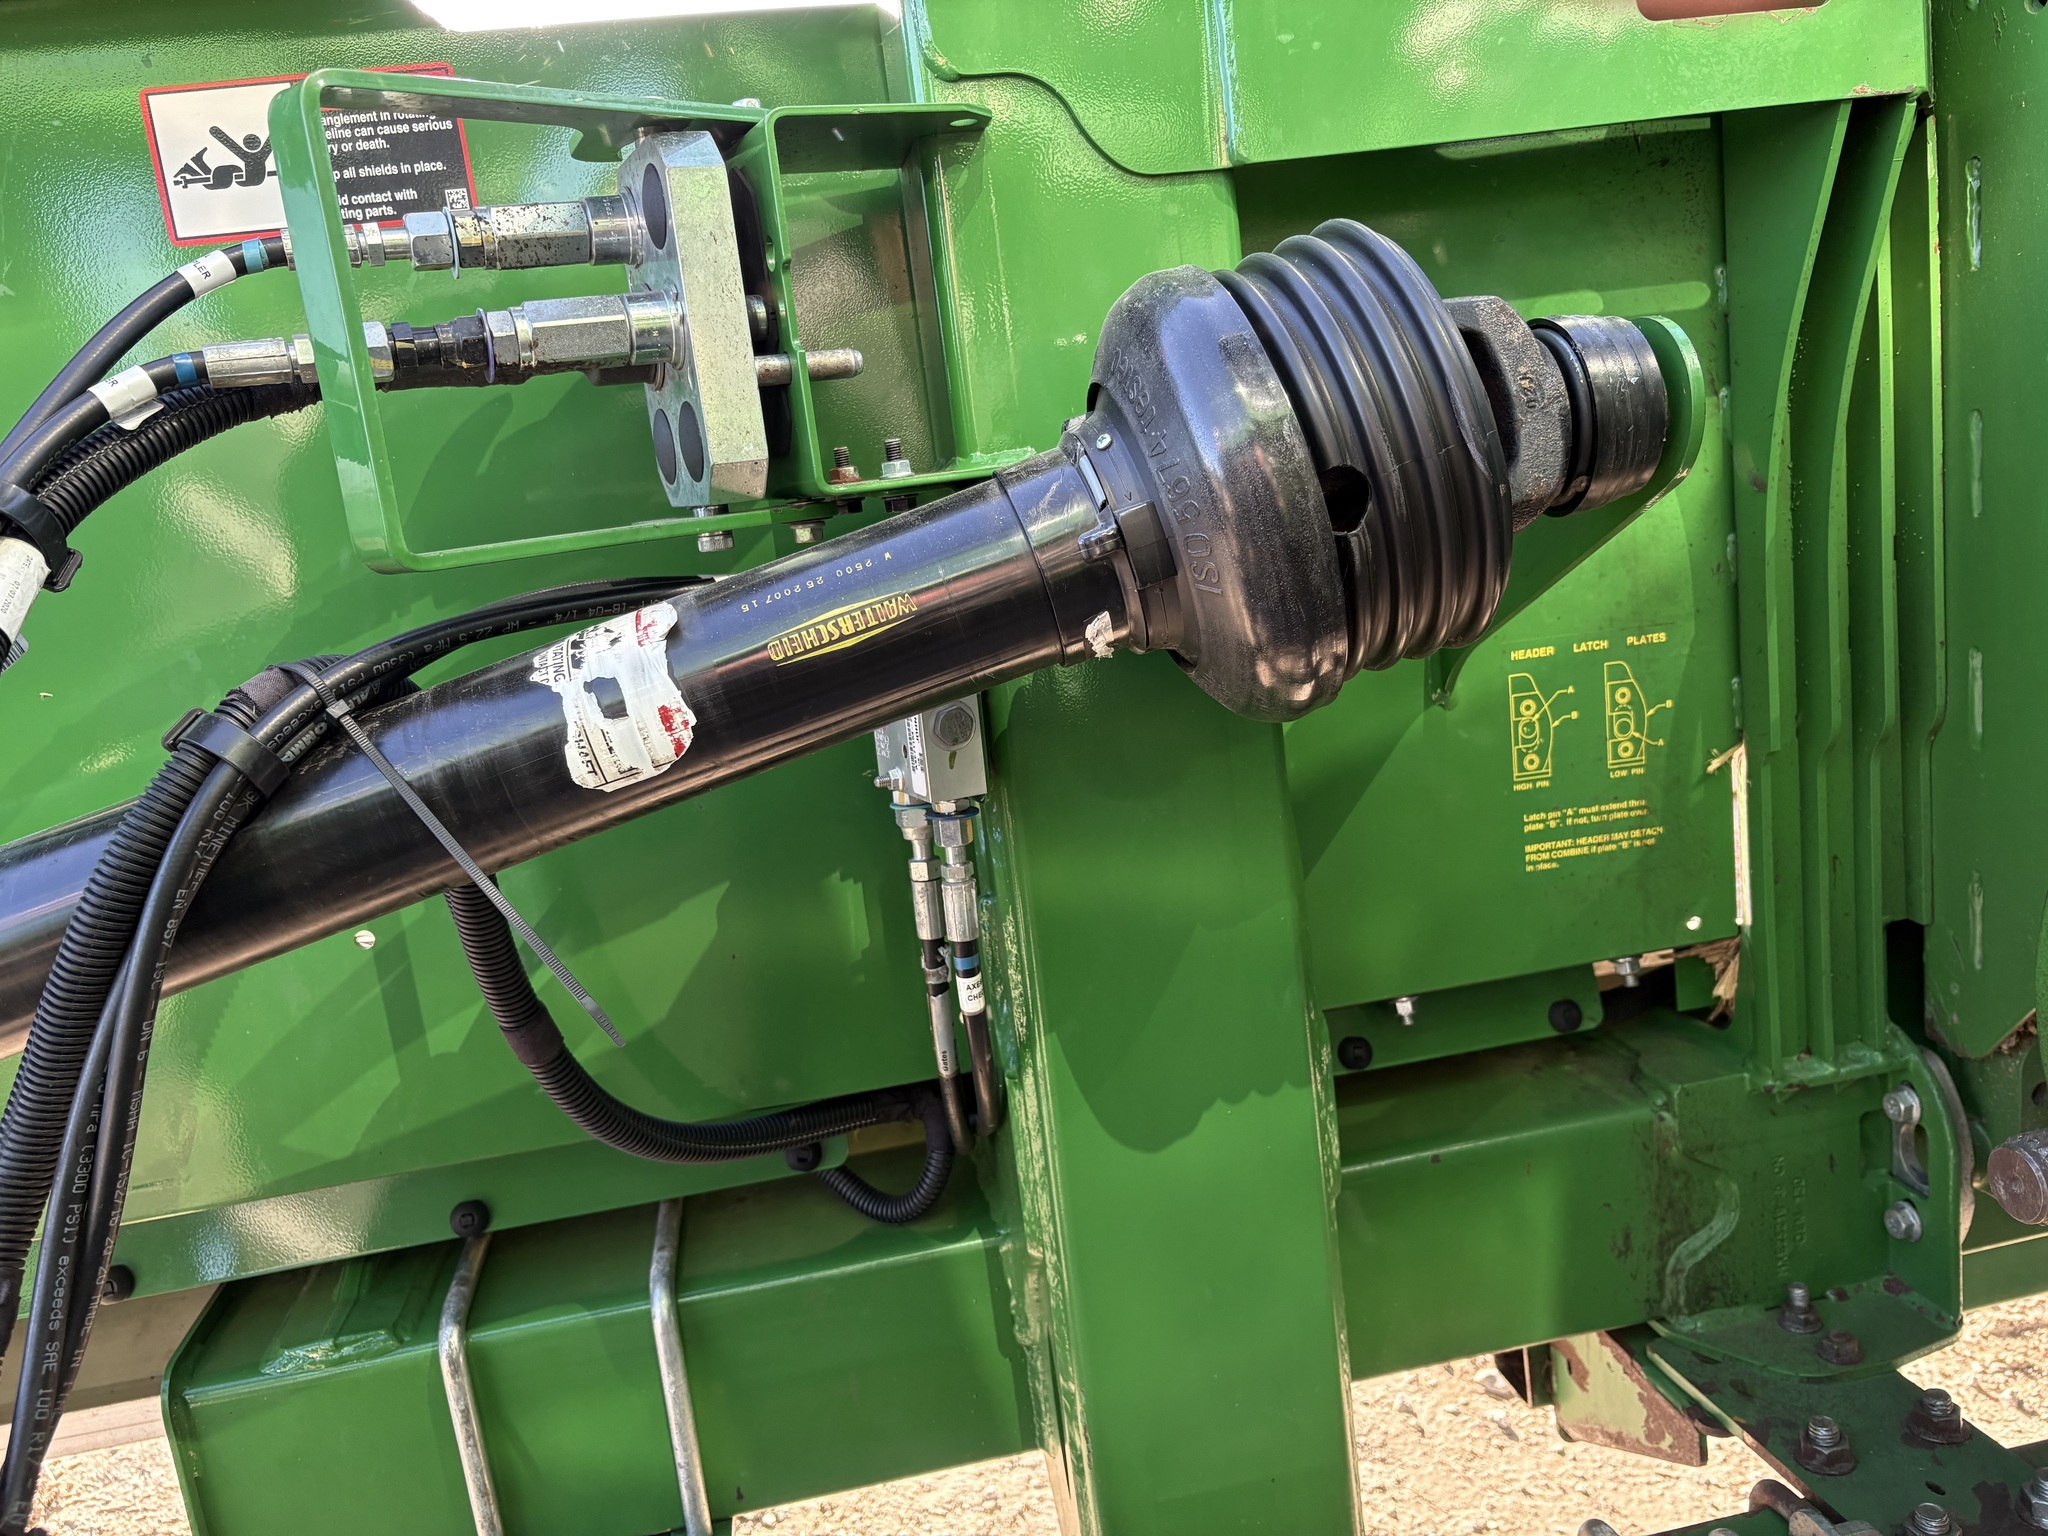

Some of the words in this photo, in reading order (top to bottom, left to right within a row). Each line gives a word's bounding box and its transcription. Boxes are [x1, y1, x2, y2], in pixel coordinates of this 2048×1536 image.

[354, 126, 374, 138] can
[376, 122, 410, 135] cause
[412, 119, 454, 132] serious
[341, 142, 353, 152] or
[356, 138, 390, 150] death.
[342, 166, 356, 179] all
[358, 163, 398, 178] shields
[400, 162, 412, 173] in
[414, 160, 447, 175] place.
[352, 190, 392, 204] contact
[394, 188, 418, 200] with
[365, 205, 397, 220] parts.
[884, 552, 893, 560] W
[1183, 532, 1224, 595] ISO
[836, 558, 873, 578] 2500
[458, 626, 493, 645] 22.5
[502, 620, 520, 634] WP
[766, 593, 918, 662] WALTERSCHEID
[424, 638, 450, 654] MPa
[1510, 646, 1555, 661] HEADER
[1573, 639, 1609, 653] LATCH
[1626, 632, 1667, 646] PLATES
[372, 650, 416, 676] (3300
[267, 700, 323, 750] exceeds
[1610, 769, 1628, 778] LOW
[1631, 767, 1644, 776] PIN
[1513, 782, 1533, 792] HIGH
[1536, 780, 1550, 789] PIN
[213, 792, 235, 821] 100
[237, 790, 260, 812] 3K
[1523, 810, 1546, 822] Latch
[1548, 811, 1562, 822] pin
[1578, 805, 1599, 815] must
[1600, 802, 1628, 812] extend
[1629, 799, 1646, 808] thru
[1524, 822, 1544, 833] plate
[1566, 817, 1573, 826] If
[1591, 814, 1608, 823] turn
[1609, 810, 1629, 822] plate
[194, 828, 216, 859] R17
[1524, 838, 1575, 854] IMPORTANT:
[1576, 833, 1610, 846] HEADER
[1611, 830, 1630, 841] MAY
[1630, 826, 1664, 838] DETACH
[1525, 852, 1550, 862] FROM
[1550, 846, 1590, 859] COMBINE
[1591, 846, 1597, 854] if
[1598, 843, 1618, 854] plate
[1633, 839, 1642, 848] is
[1642, 838, 1655, 846] not
[1526, 863, 1535, 872] in
[1536, 861, 1560, 872] place.
[172, 888, 188, 911] EN
[161, 918, 180, 948] 857
[140, 1018, 156, 1042] DN
[126, 1088, 143, 1132] MSHA
[72, 1143, 95, 1194] (3300
[62, 1203, 83, 1245] PSI)
[48, 1255, 70, 1332] exceeds
[41, 1341, 60, 1376] SAE
[34, 1388, 54, 1422] 100
